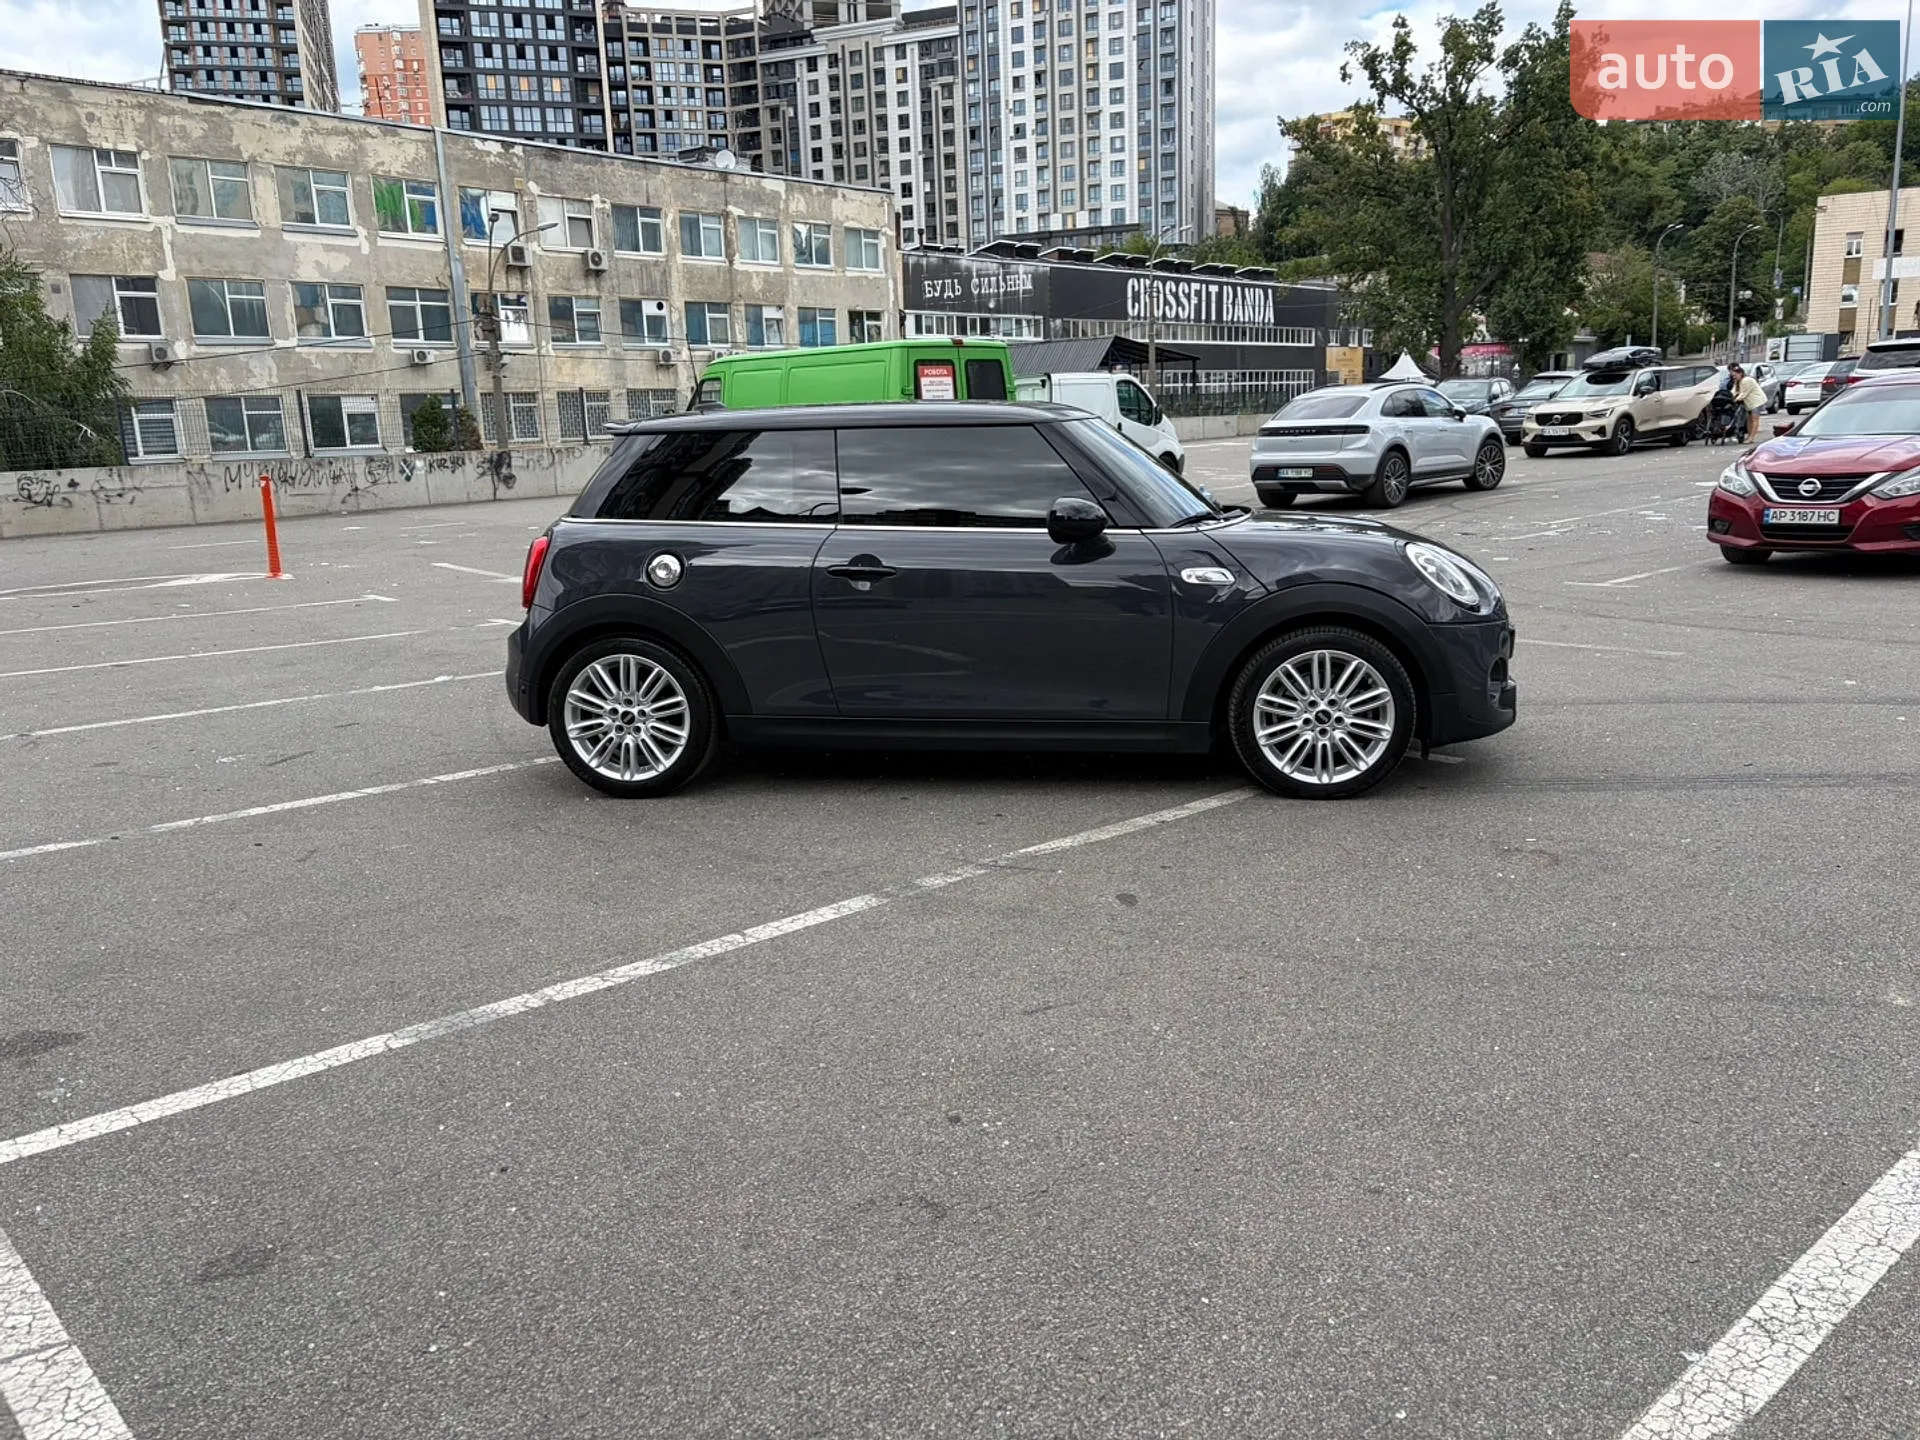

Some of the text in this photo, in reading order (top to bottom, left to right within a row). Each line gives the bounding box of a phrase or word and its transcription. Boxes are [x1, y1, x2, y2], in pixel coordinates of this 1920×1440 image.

[924, 274, 1033, 299] БУДЬ СИЛЬНЫМ
[1127, 277, 1275, 324] CROSSFIT BANDA
[1771, 510, 1836, 522] AP 3187 HC
